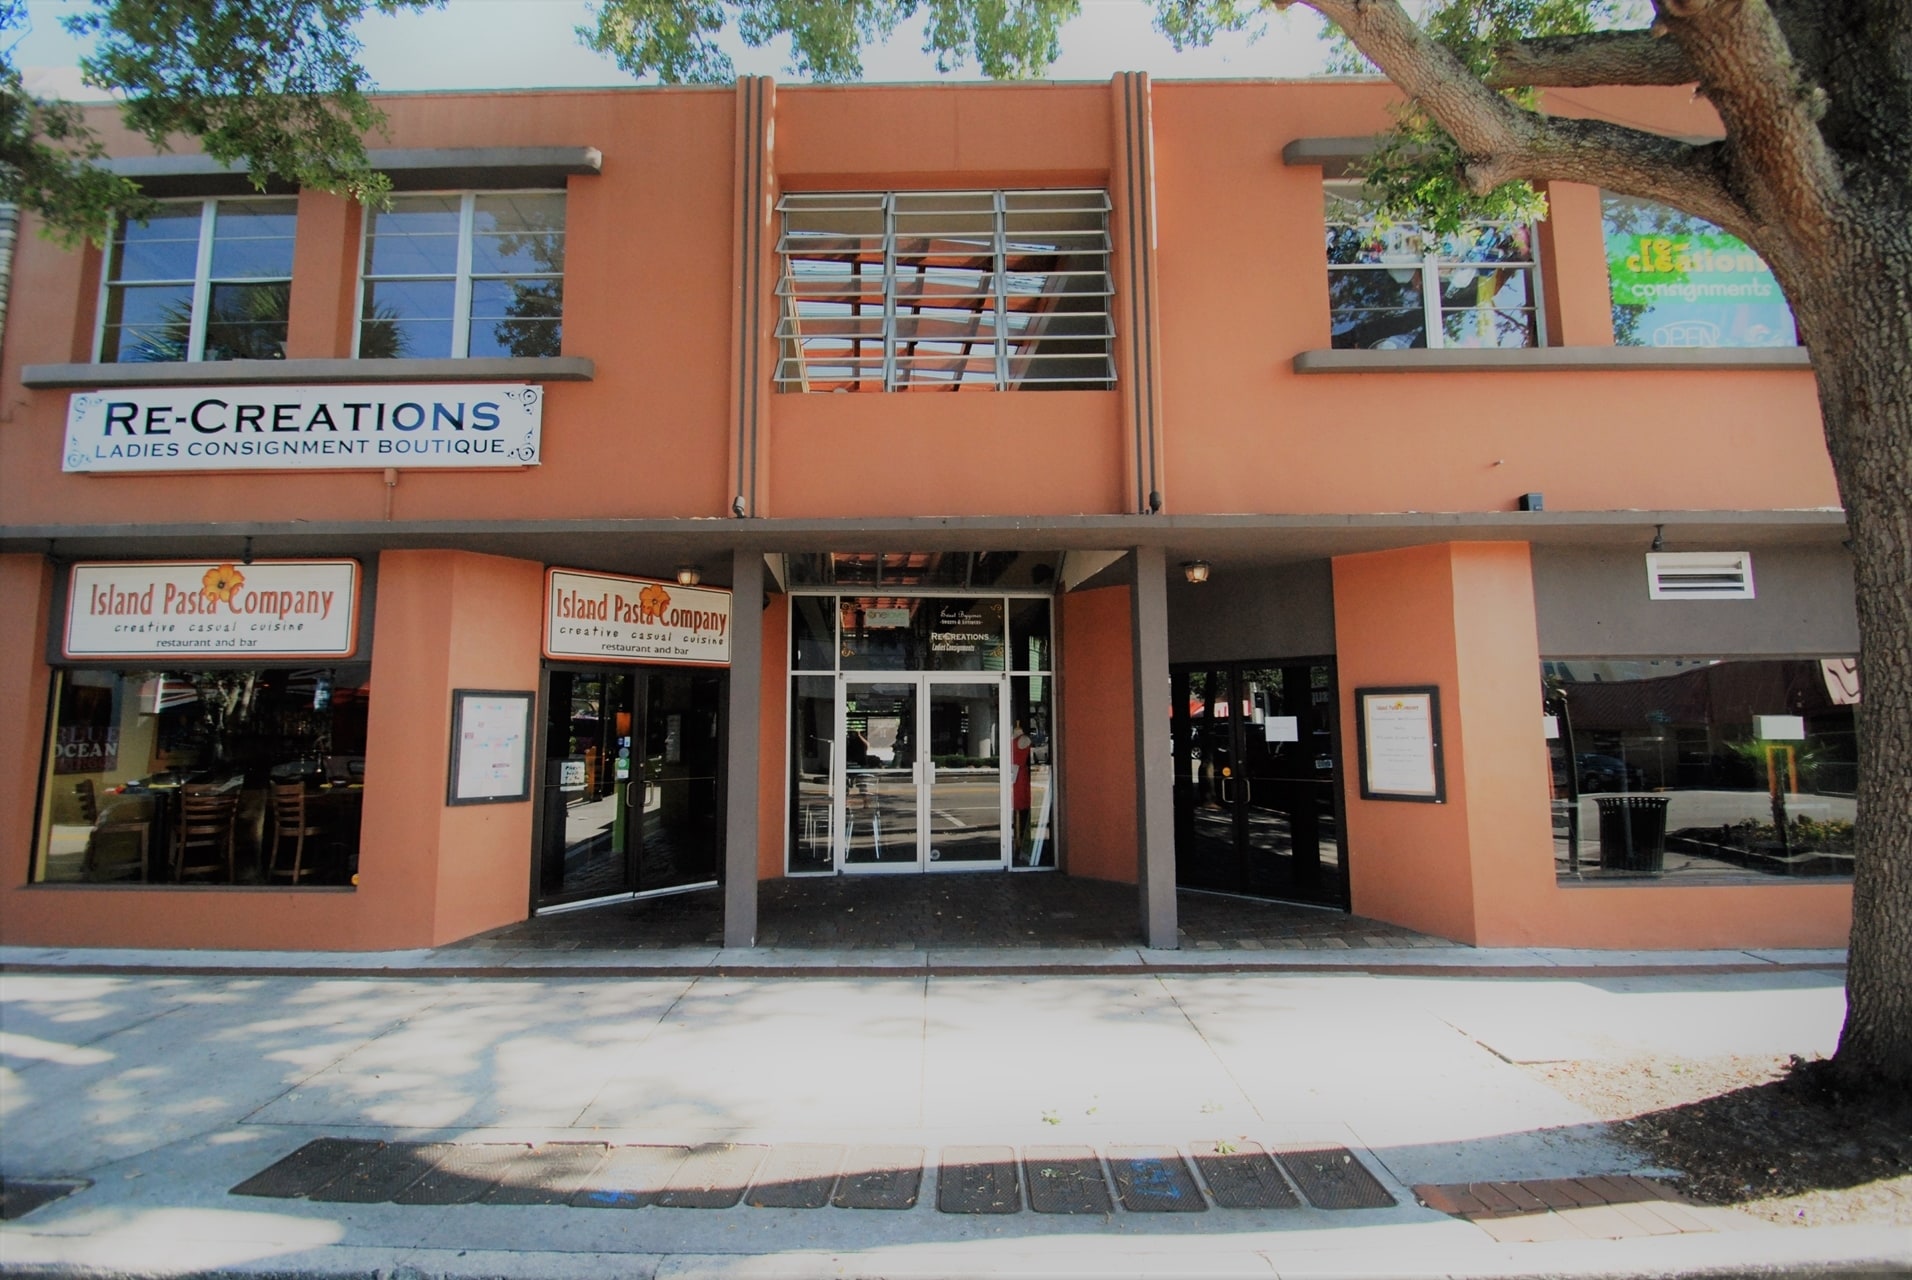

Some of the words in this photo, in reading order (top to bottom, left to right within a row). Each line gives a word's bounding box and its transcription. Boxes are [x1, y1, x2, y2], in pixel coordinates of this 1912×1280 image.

[1631, 277, 1772, 302] consignments
[1653, 326, 1716, 347] OPEN
[103, 398, 501, 436] RE-CREATIONS
[95, 442, 180, 459] LADIES
[187, 439, 370, 457] CONSIGNMENT
[378, 438, 505, 454] BOUTIQUE
[90, 583, 155, 615] Island
[163, 582, 218, 614] Pasta
[229, 582, 334, 621] Company
[556, 588, 609, 622] Island
[613, 594, 654, 626] Pasta
[659, 599, 728, 636] Company
[114, 620, 176, 633] creative
[188, 621, 237, 632] casual
[250, 621, 304, 632] cuisine
[559, 626, 619, 639] creative
[631, 631, 672, 642] casual
[683, 635, 724, 646] cuisine
[156, 638, 211, 648] restaurant
[215, 637, 236, 648] and
[239, 637, 258, 648] bar
[601, 643, 651, 654] restaurant
[654, 644, 672, 655] and
[674, 646, 689, 656] bar
[55, 742, 118, 758] OCEAN
